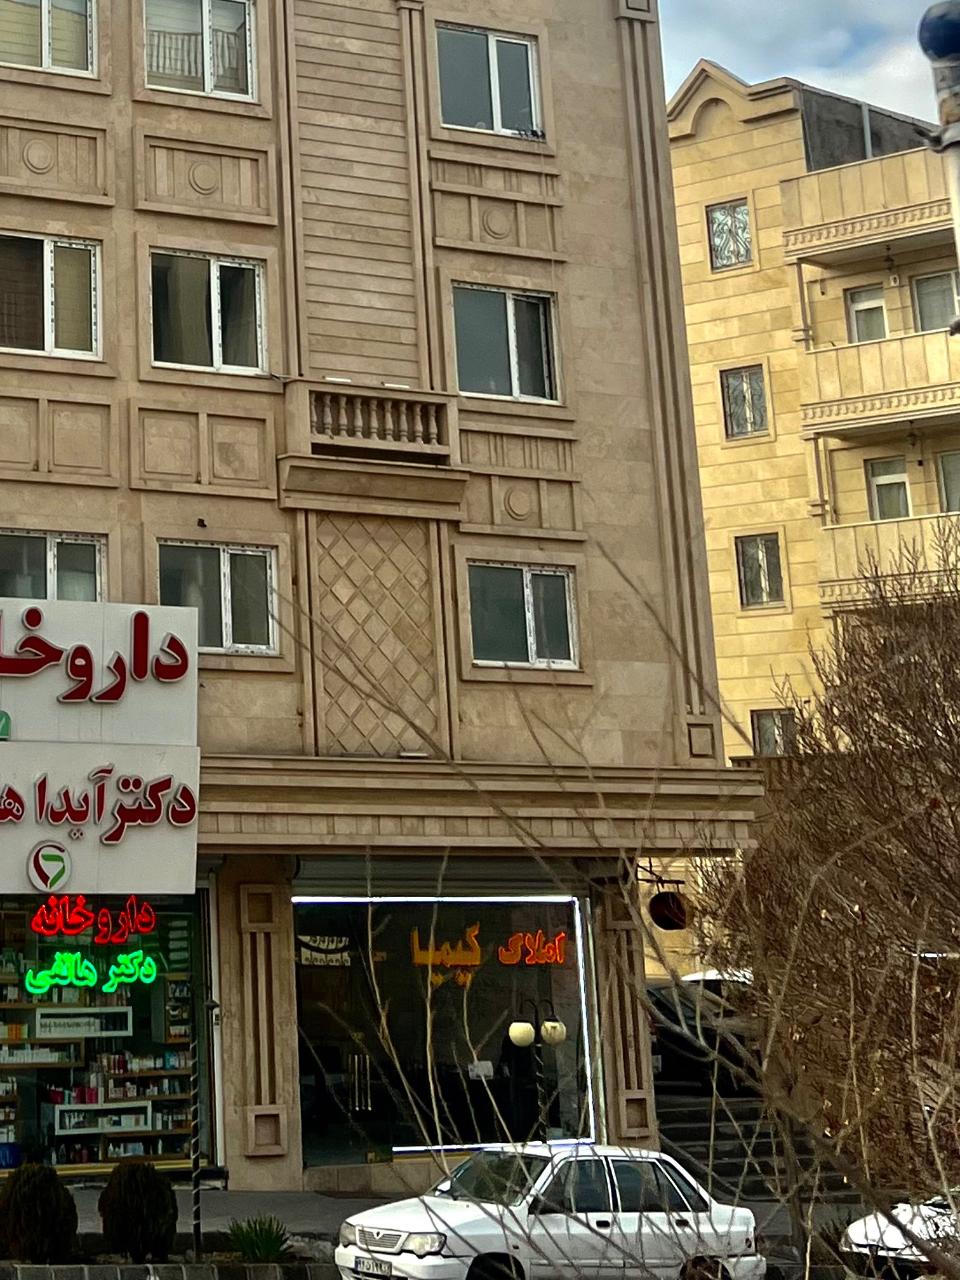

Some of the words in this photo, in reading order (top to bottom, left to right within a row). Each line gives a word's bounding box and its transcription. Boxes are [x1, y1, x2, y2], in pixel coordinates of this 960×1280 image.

[34, 762, 115, 840] آیدا
[100, 774, 198, 845] دکتر
[30, 894, 157, 945] داروخانه
[497, 929, 567, 965] املاک
[25, 951, 98, 994] هاتفی
[101, 949, 158, 993] دکتر
